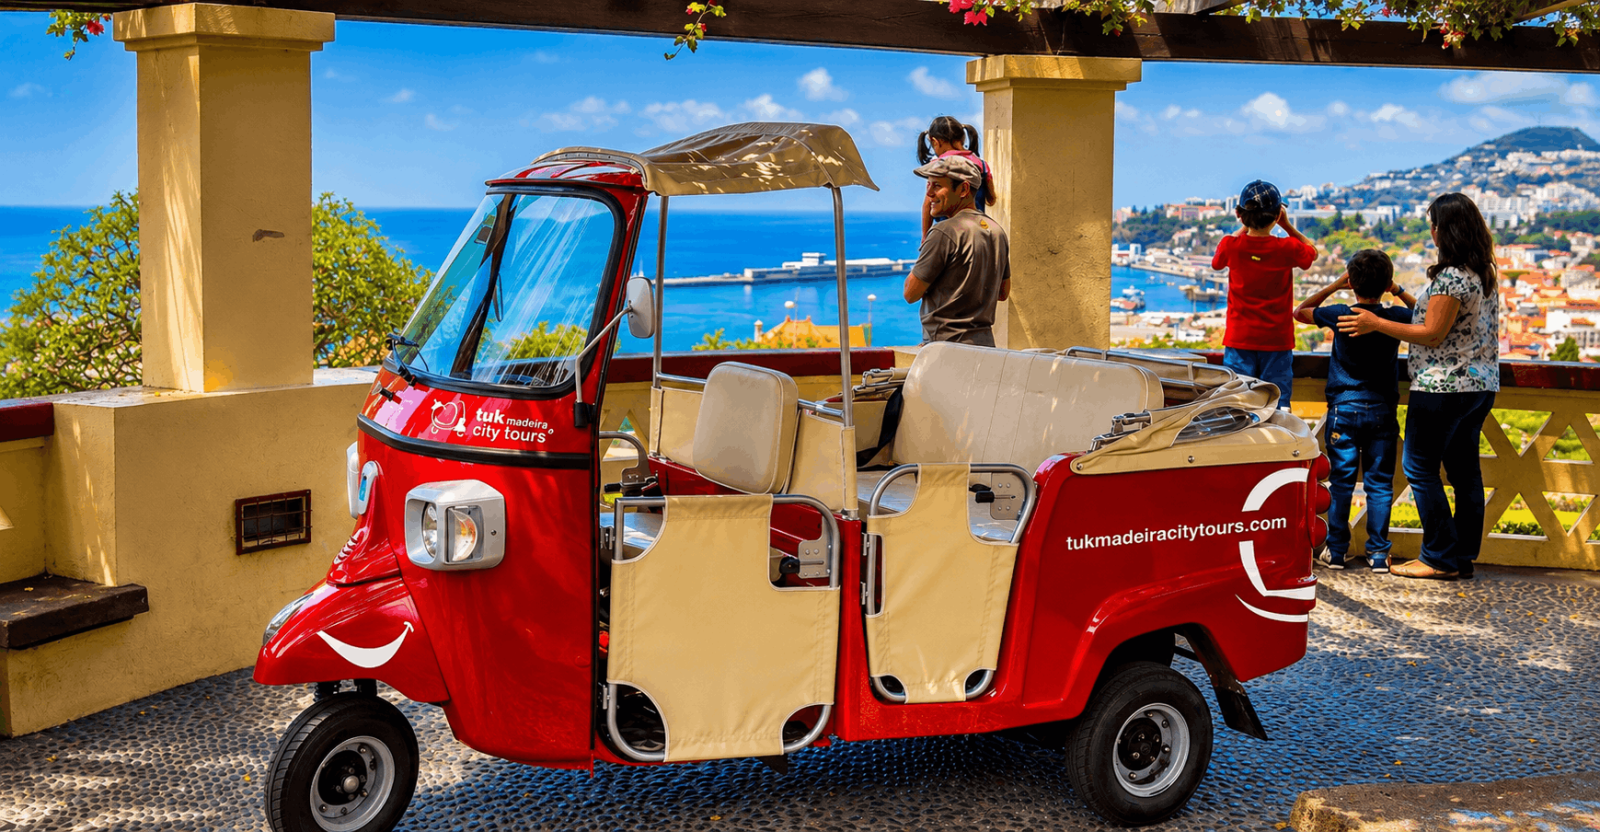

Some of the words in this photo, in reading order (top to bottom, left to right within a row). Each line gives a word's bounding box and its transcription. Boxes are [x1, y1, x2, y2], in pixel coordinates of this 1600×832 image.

[476, 408, 505, 424] tuk
[506, 418, 548, 429] madeira
[472, 424, 501, 442] city
[1066, 517, 1287, 550] tukmadeiracitytours.com
